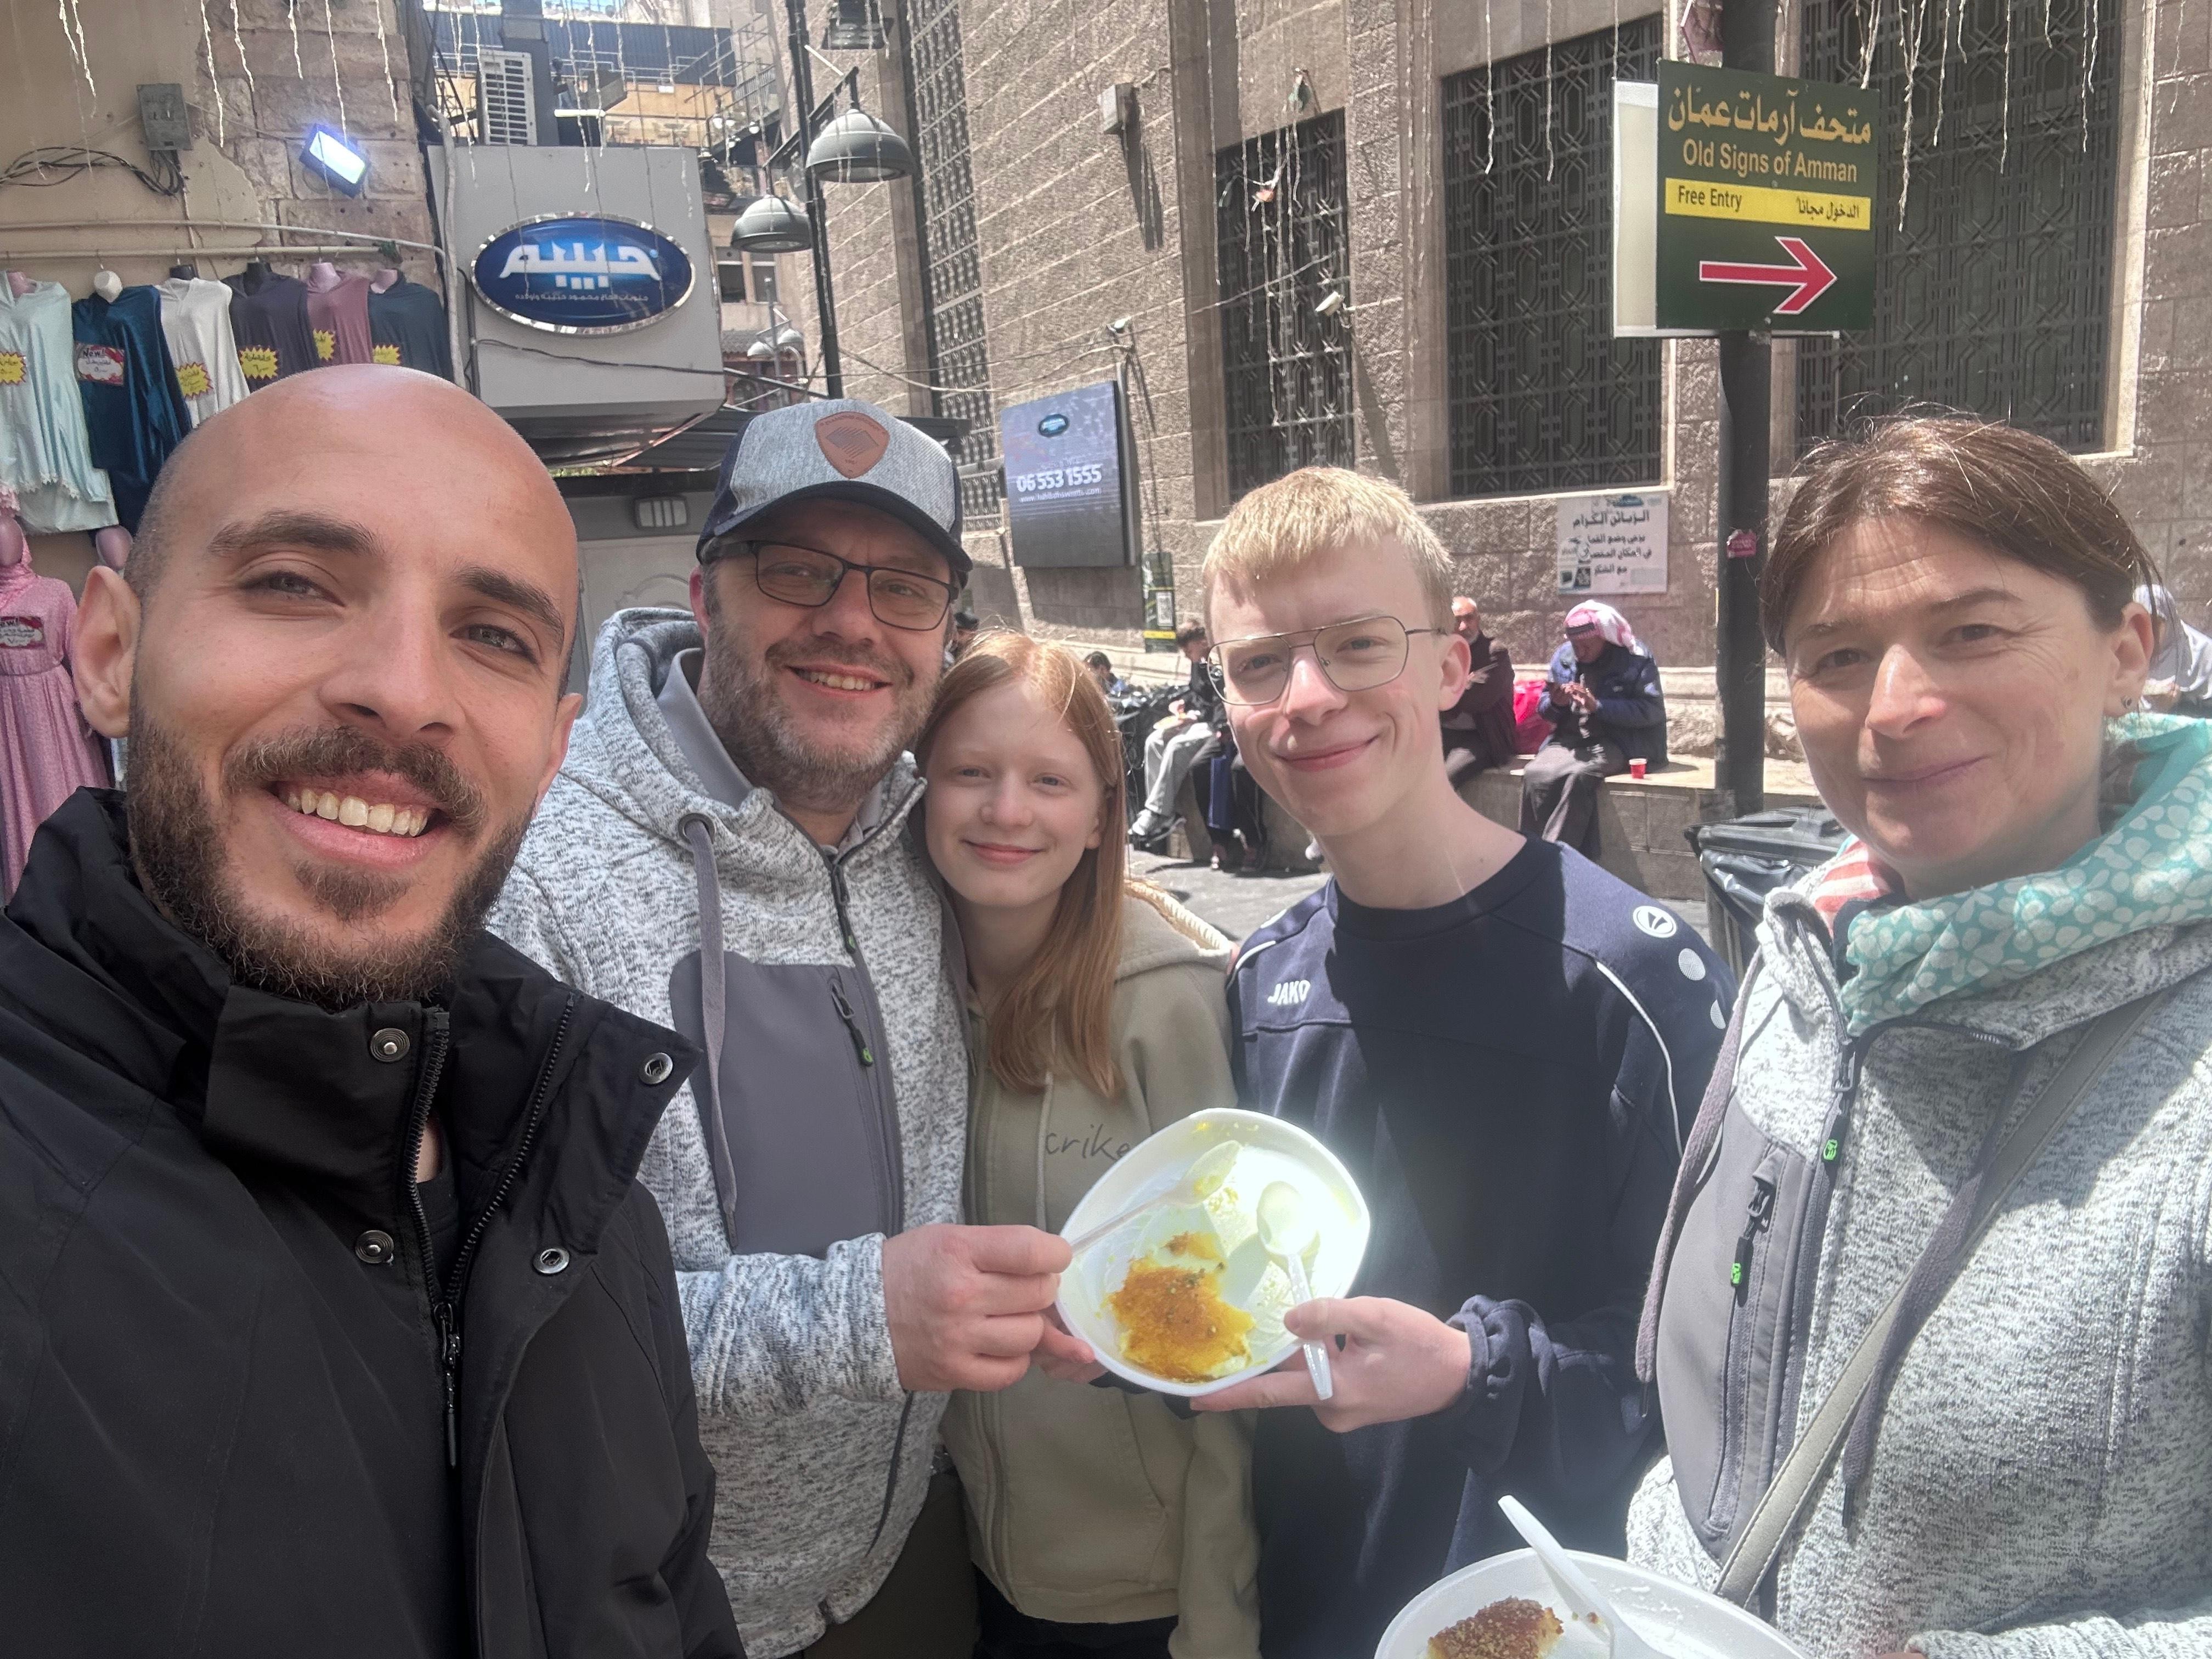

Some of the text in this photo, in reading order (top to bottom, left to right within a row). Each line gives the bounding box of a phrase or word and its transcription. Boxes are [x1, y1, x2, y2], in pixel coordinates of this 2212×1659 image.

[1800, 103, 1871, 145] متحف
[1683, 138, 1857, 183] Old Signs of Amman
[1678, 185, 1742, 213] Free Entry
[1826, 202, 1860, 222] الدخول
[1573, 511, 1607, 529] الكرام
[1267, 980, 1311, 1006] JAKO
